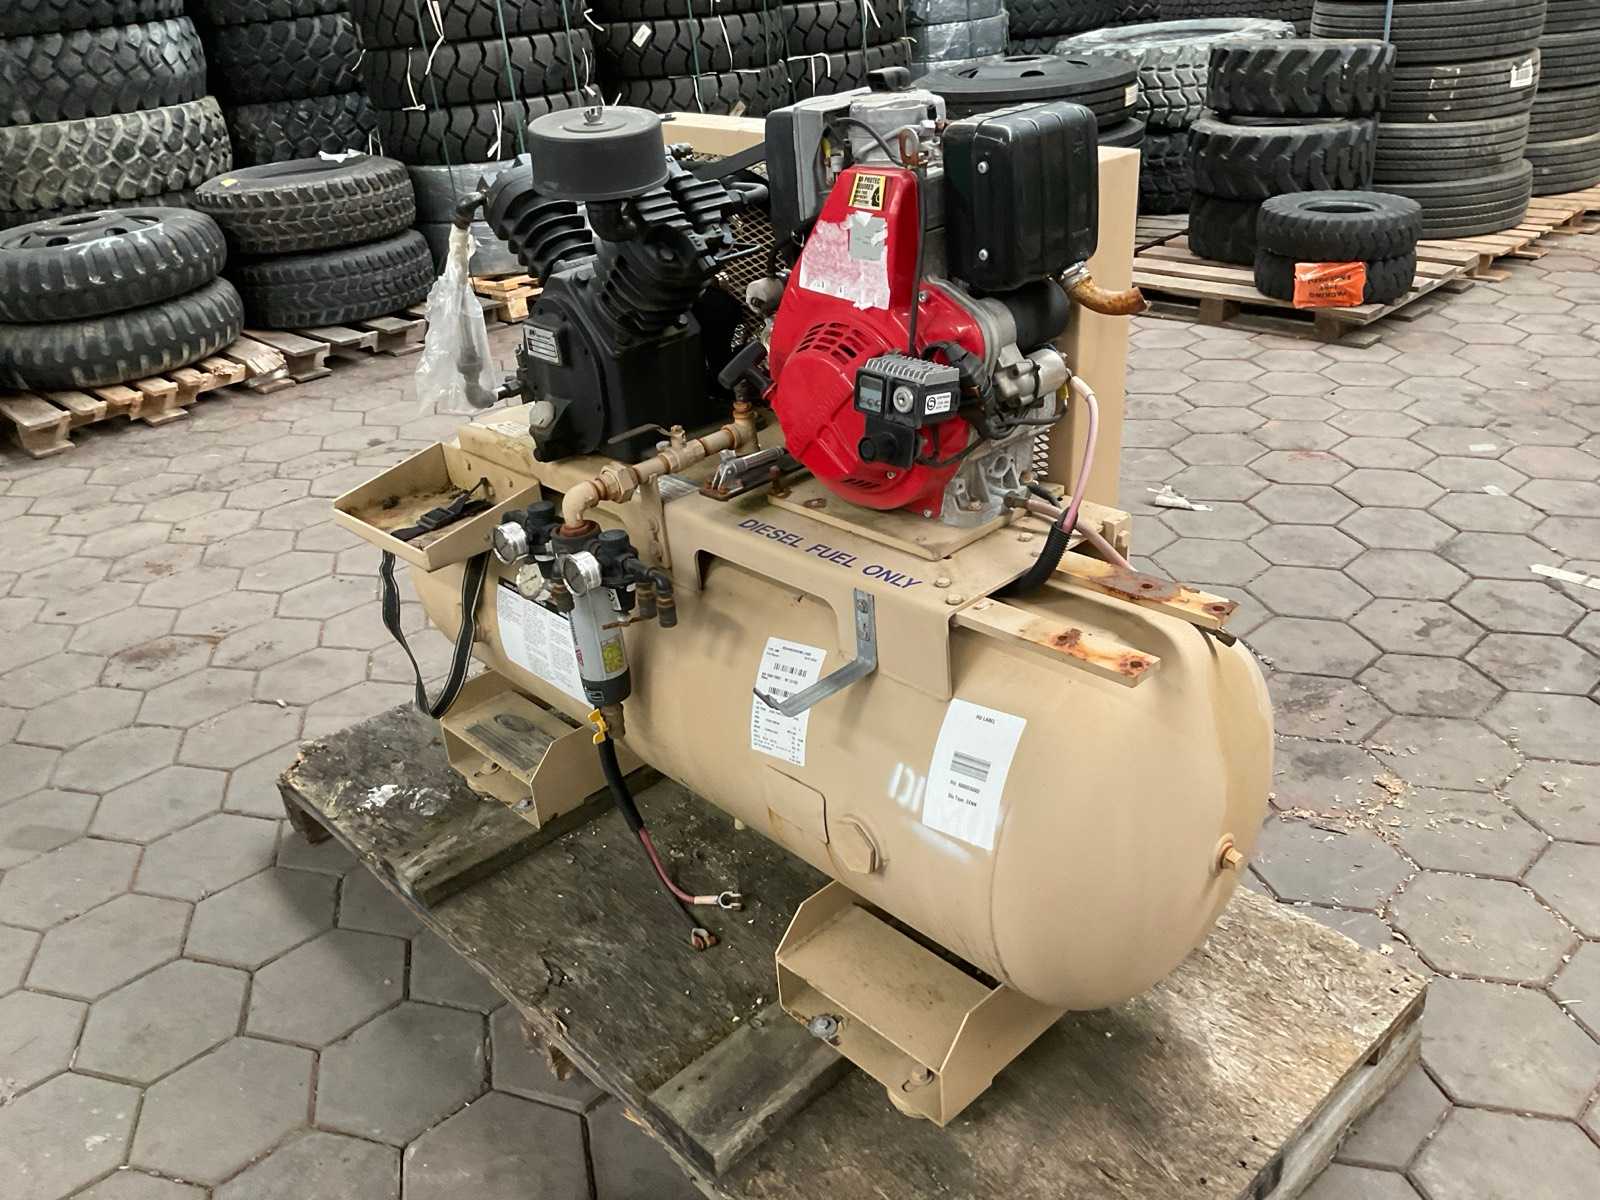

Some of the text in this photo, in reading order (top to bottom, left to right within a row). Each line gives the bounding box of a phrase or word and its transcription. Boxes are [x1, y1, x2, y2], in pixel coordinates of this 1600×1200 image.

[738, 519, 924, 589] DIESEL FUEL ONLY
